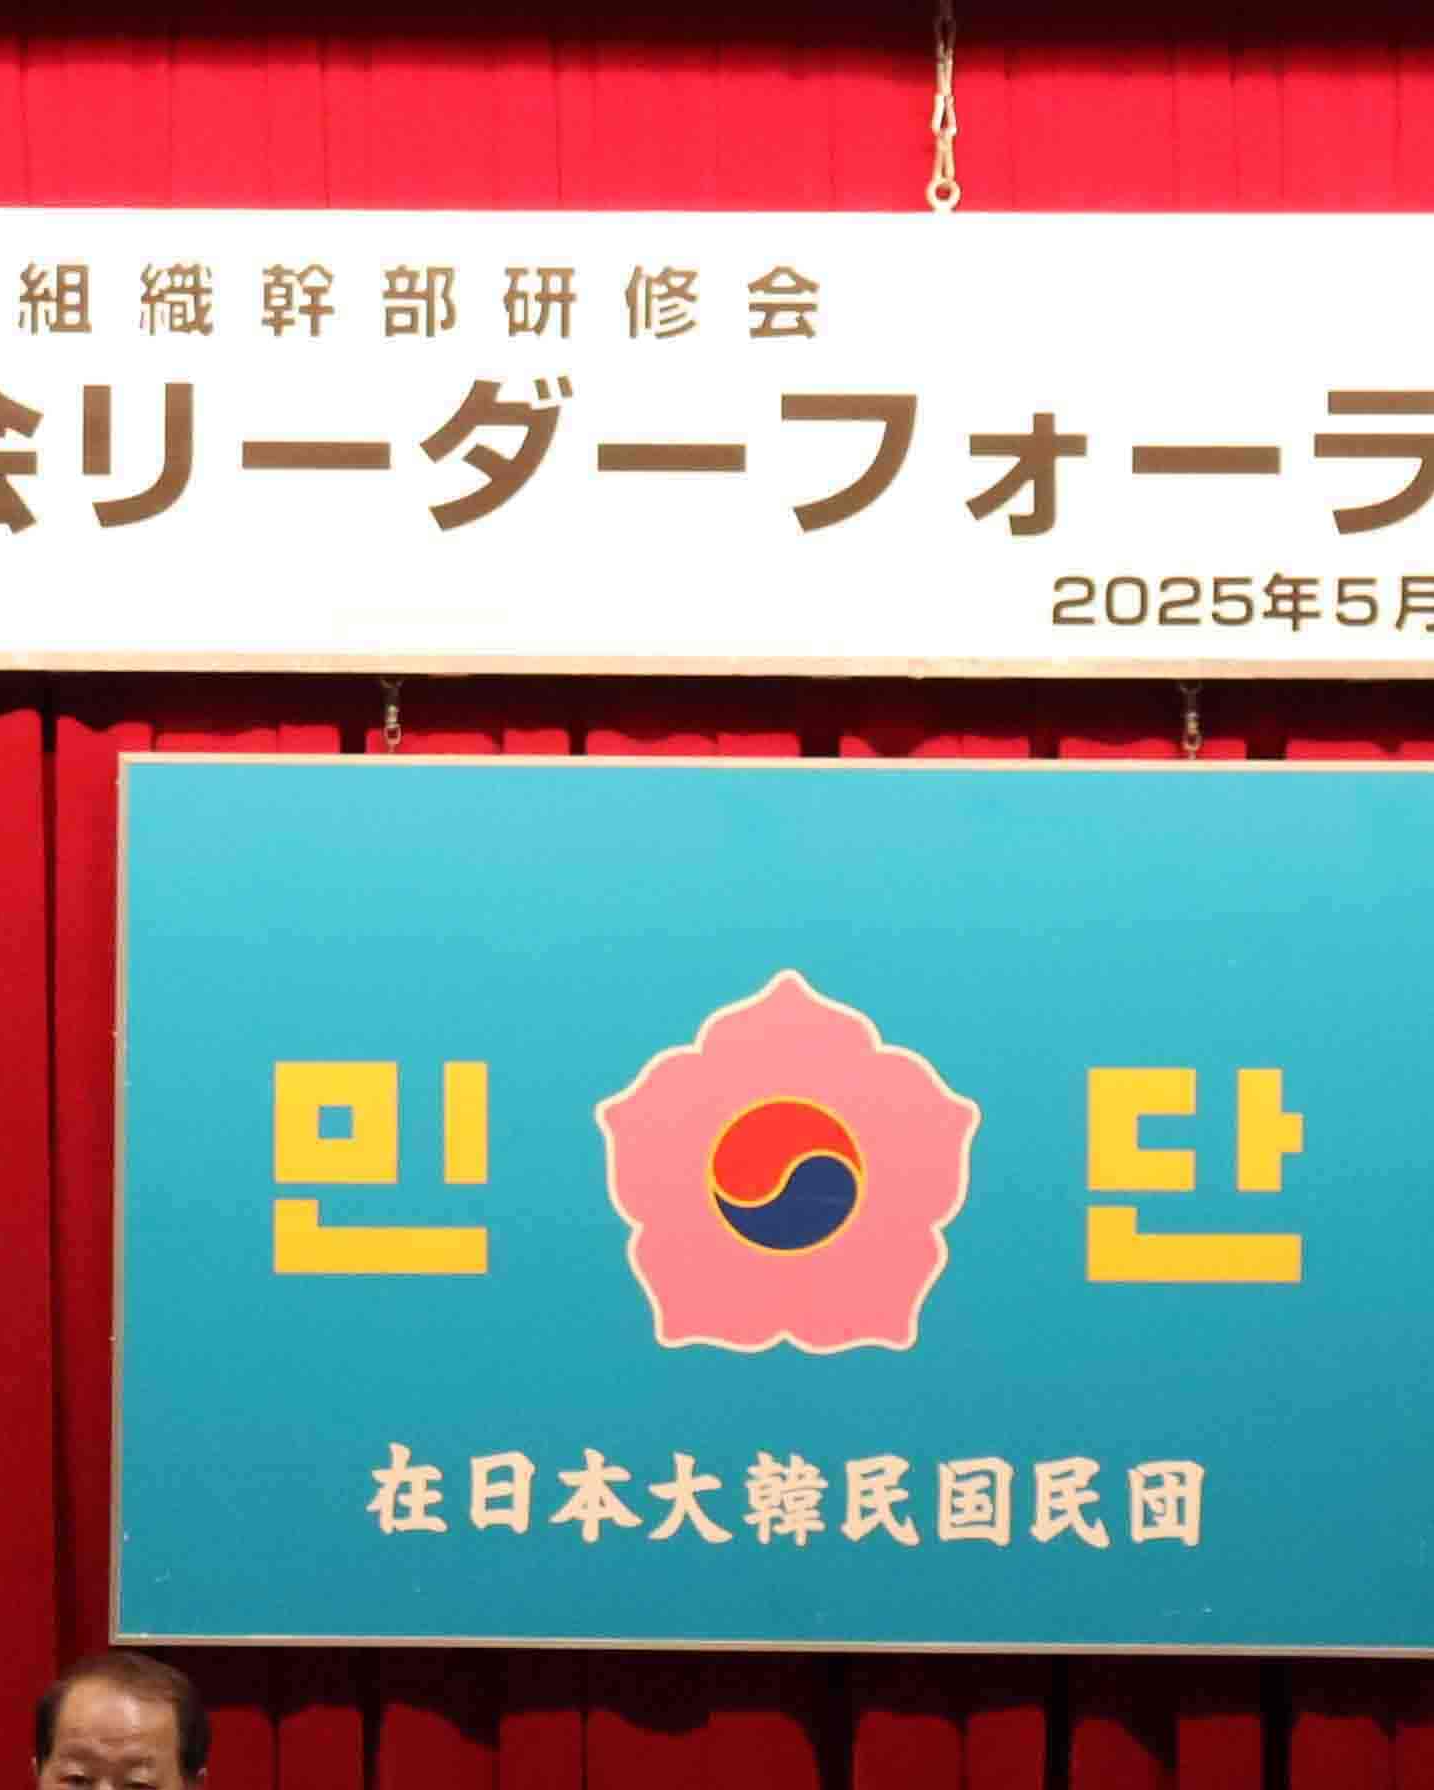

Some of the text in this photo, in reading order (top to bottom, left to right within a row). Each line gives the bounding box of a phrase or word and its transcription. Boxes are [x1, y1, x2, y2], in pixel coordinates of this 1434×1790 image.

[274, 1061, 1302, 1282] 민 단
[367, 1443, 1204, 1547] 在日本大韓民国民団
